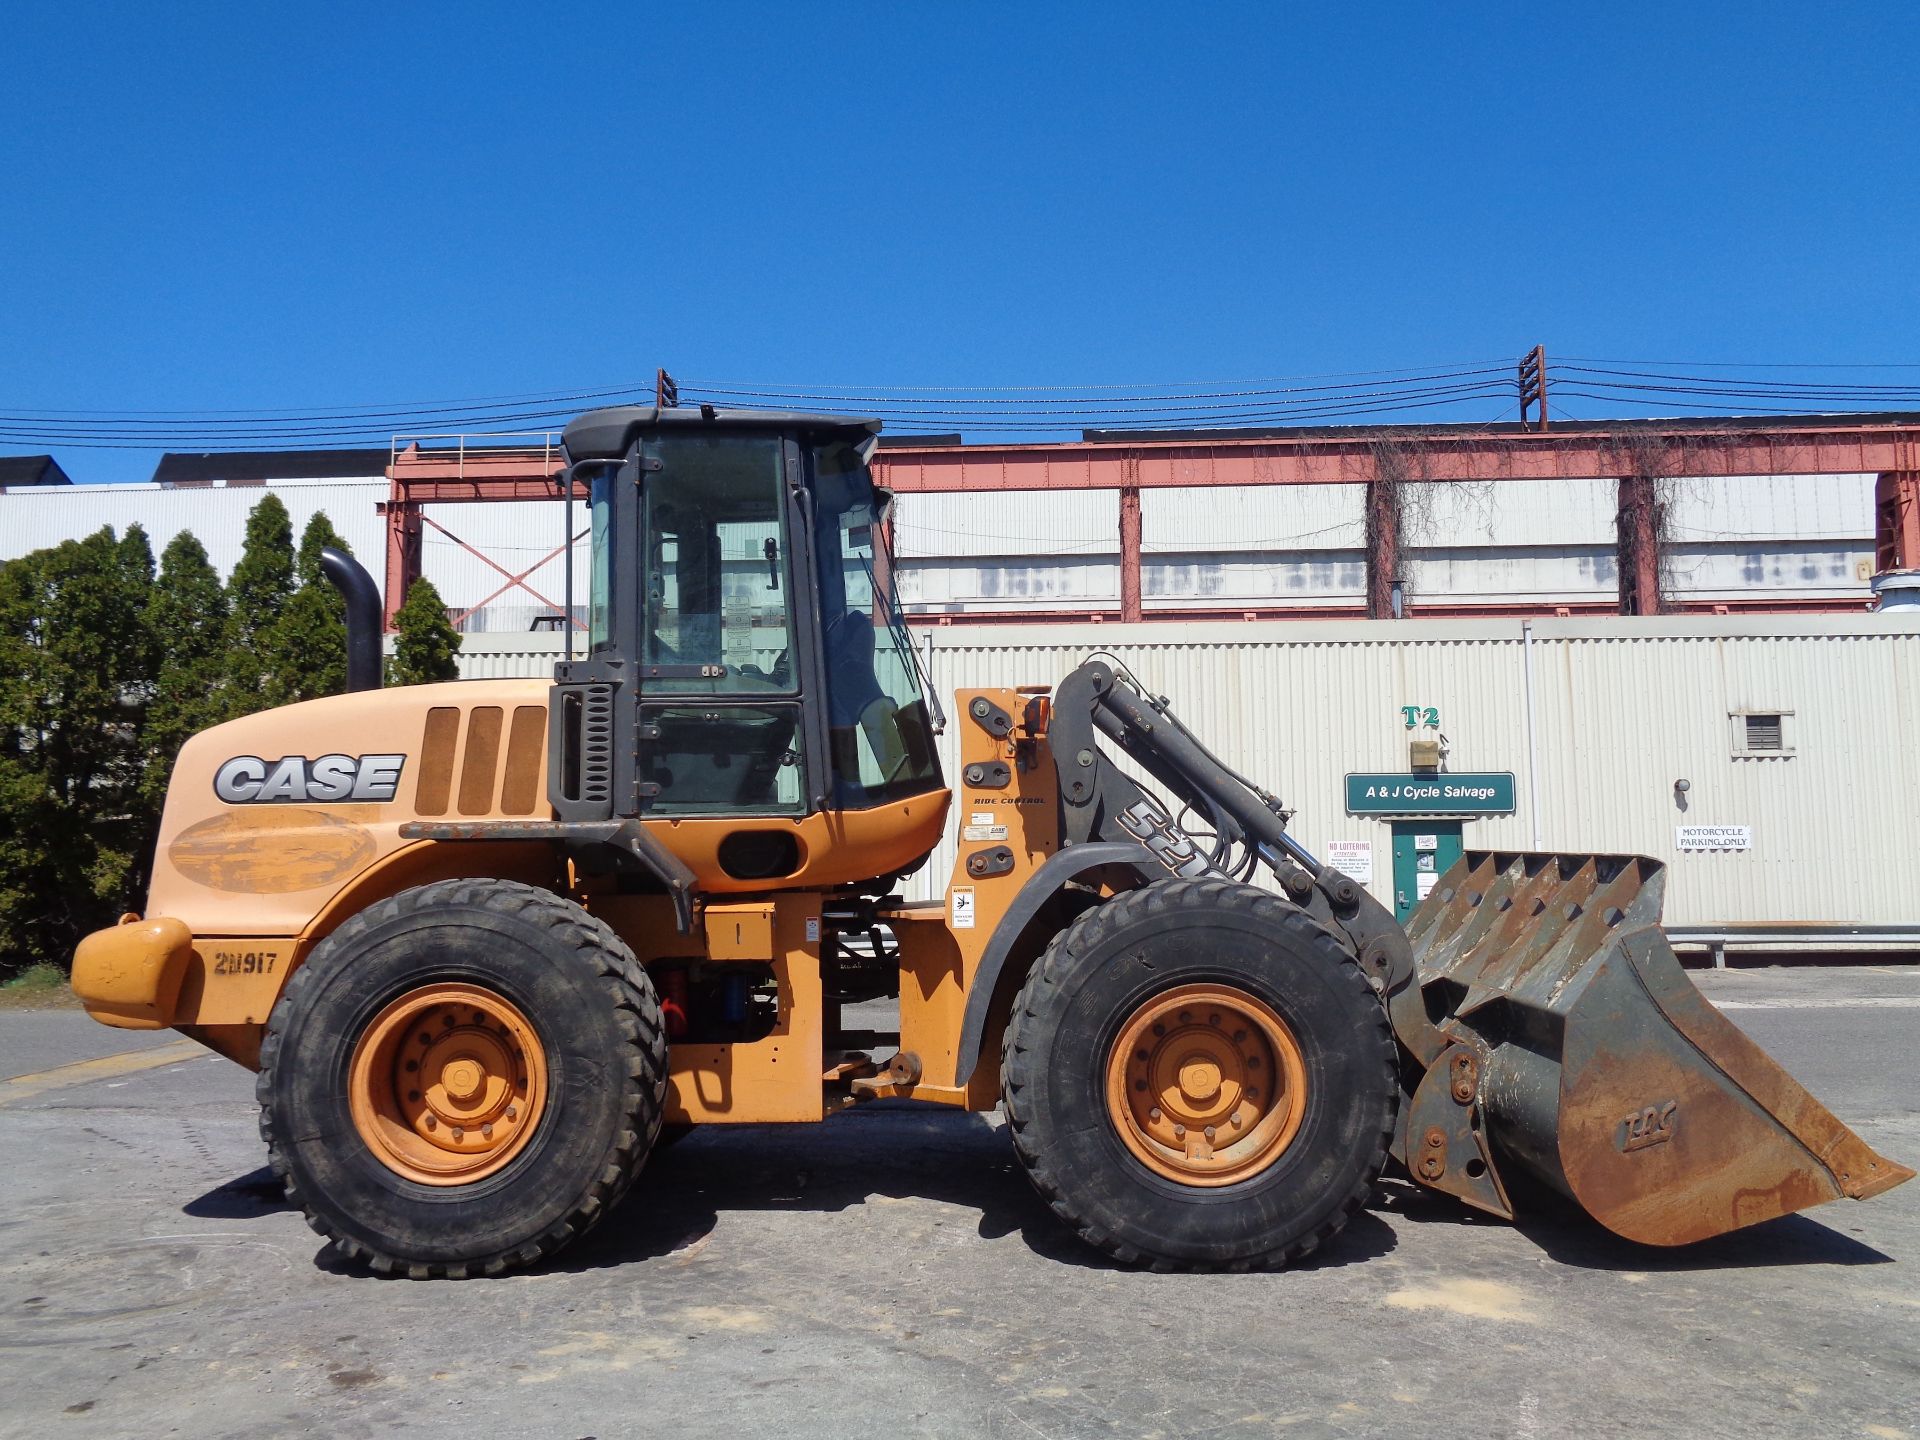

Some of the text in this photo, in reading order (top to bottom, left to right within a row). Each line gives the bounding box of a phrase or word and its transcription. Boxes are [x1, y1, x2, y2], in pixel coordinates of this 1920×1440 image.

[1402, 705, 1440, 727] T2
[214, 754, 406, 803] CASE
[1366, 786, 1495, 800] A & J Cycle Salvage
[1682, 828, 1744, 836] MOTORCYCLE
[1115, 799, 1231, 880] 521
[1329, 842, 1370, 851] NO LOITERING
[1680, 838, 1748, 846] PARKING ONLY
